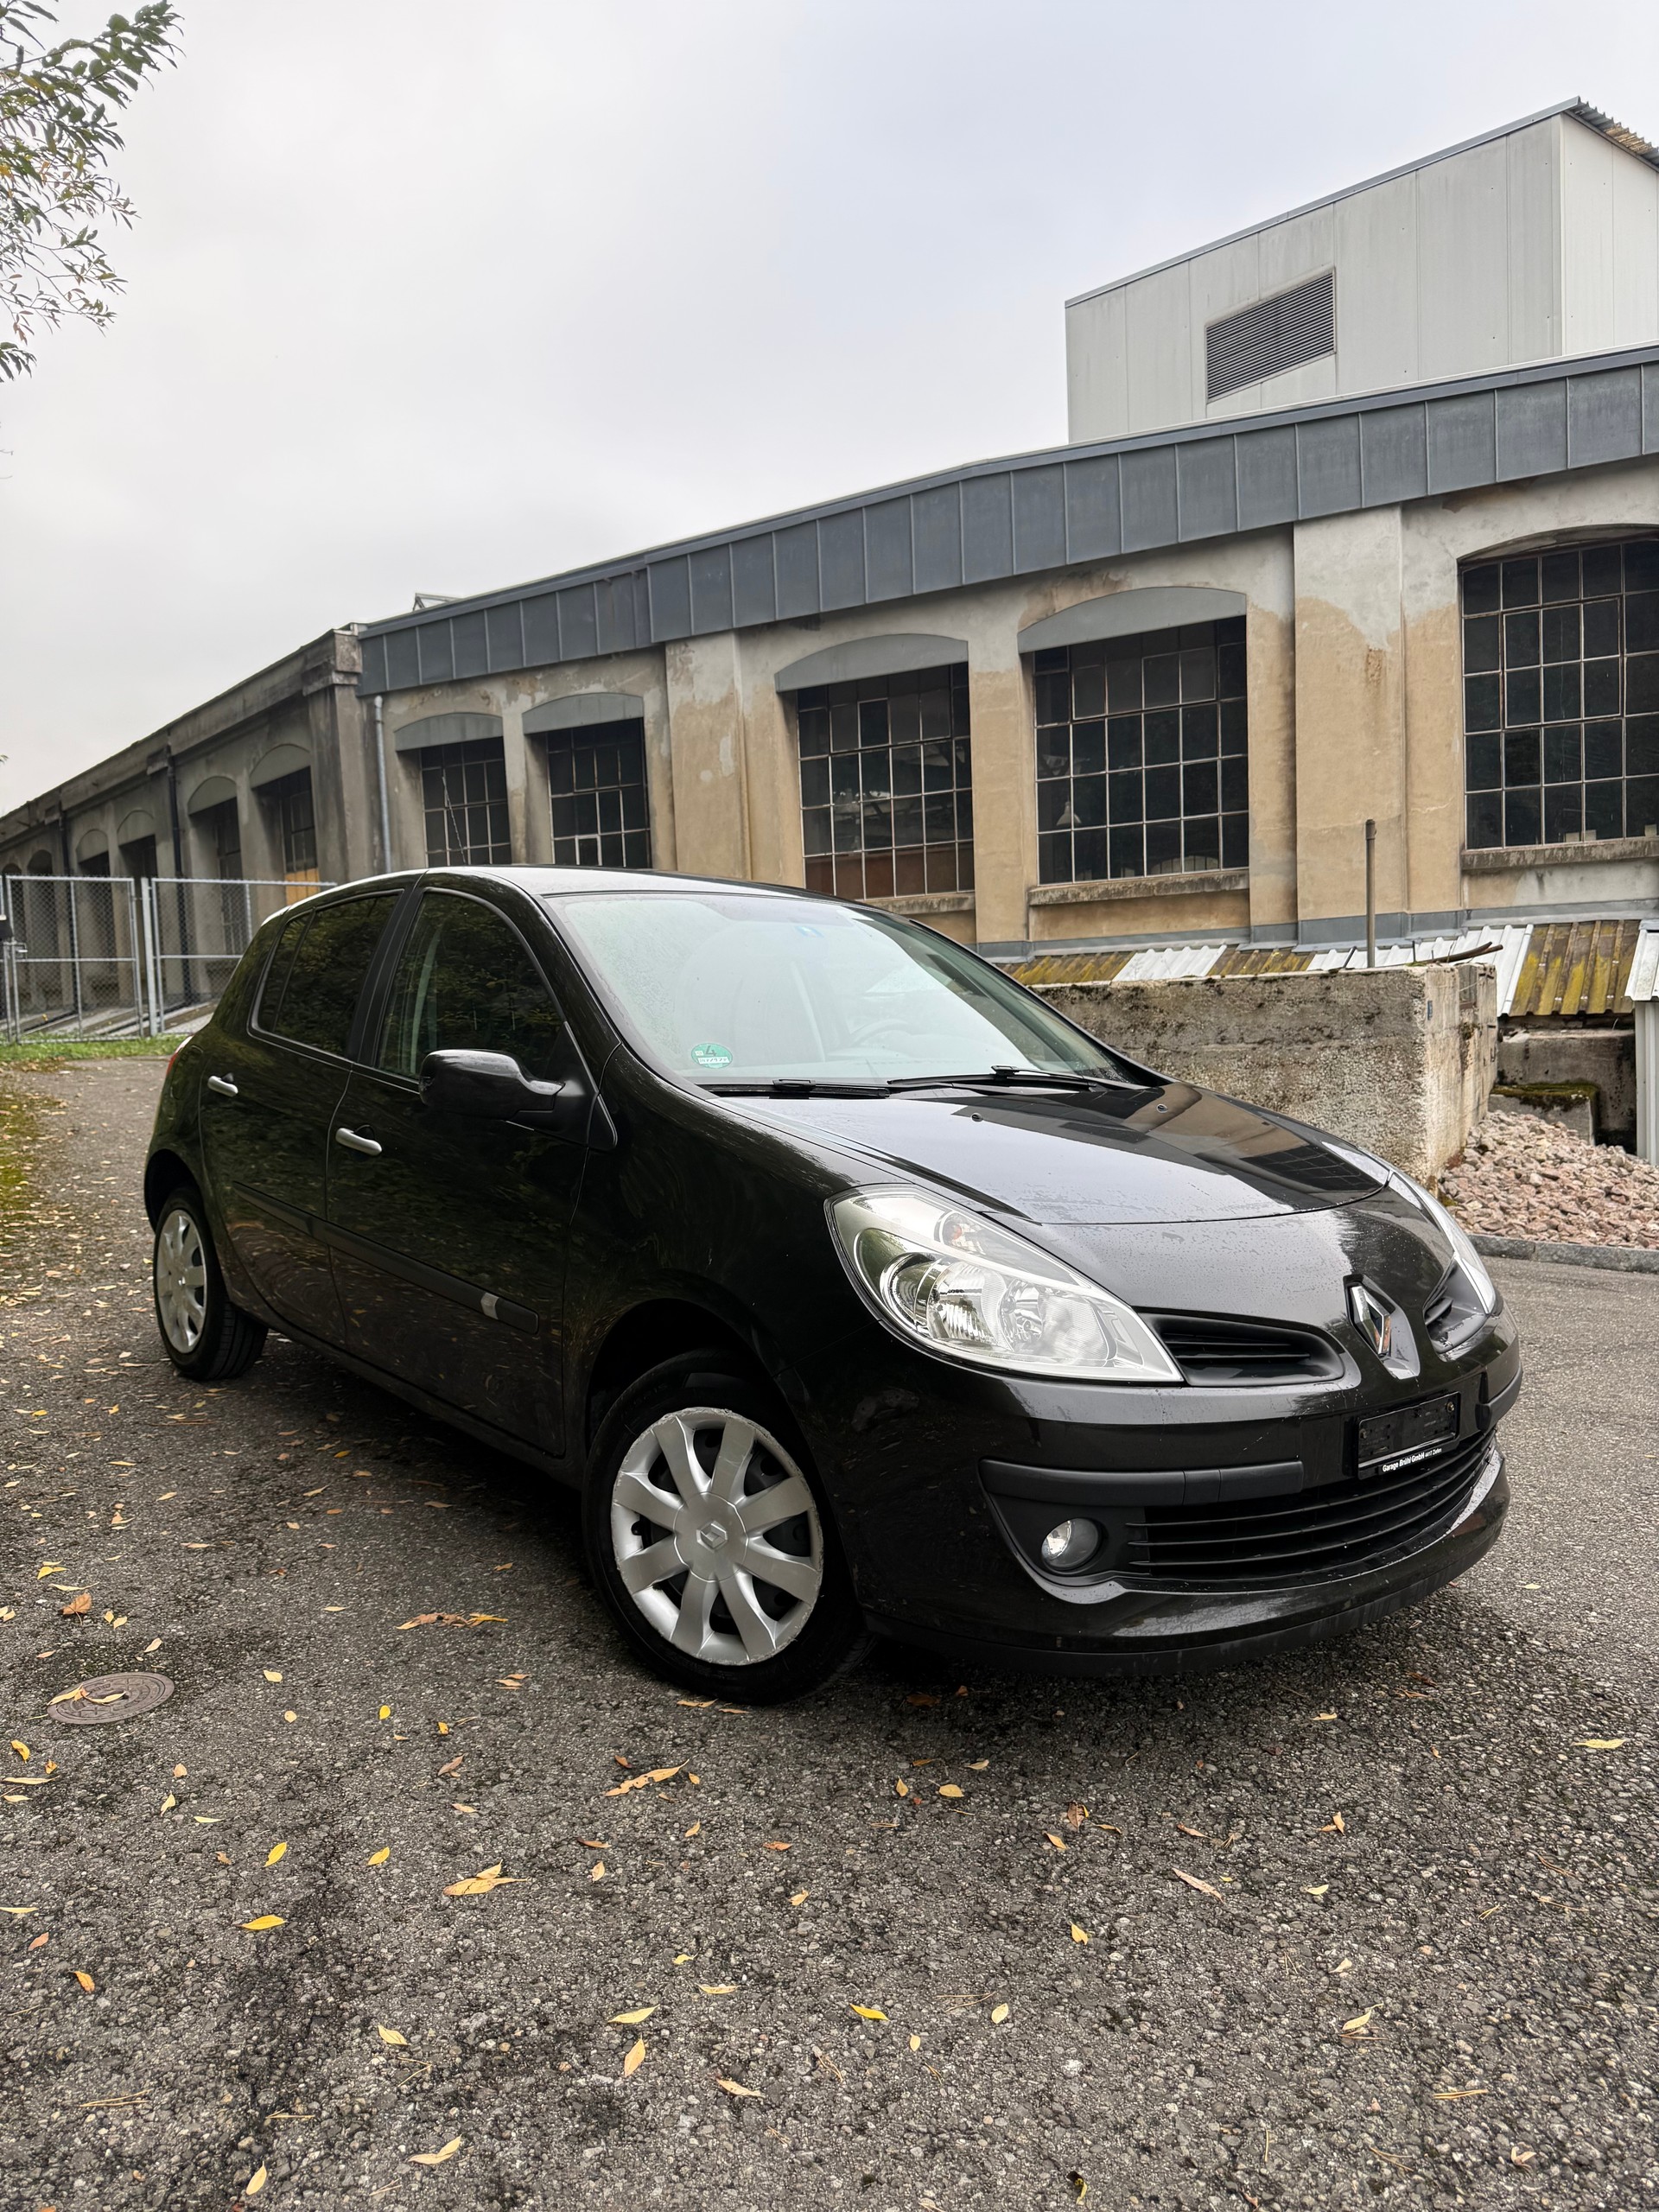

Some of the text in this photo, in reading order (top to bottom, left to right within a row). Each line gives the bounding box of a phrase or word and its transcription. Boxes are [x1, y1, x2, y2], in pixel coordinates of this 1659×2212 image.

[705, 1045, 717, 1057] 4
[1382, 1462, 1399, 1472] Garage
[1411, 1452, 1425, 1463] GmbH
